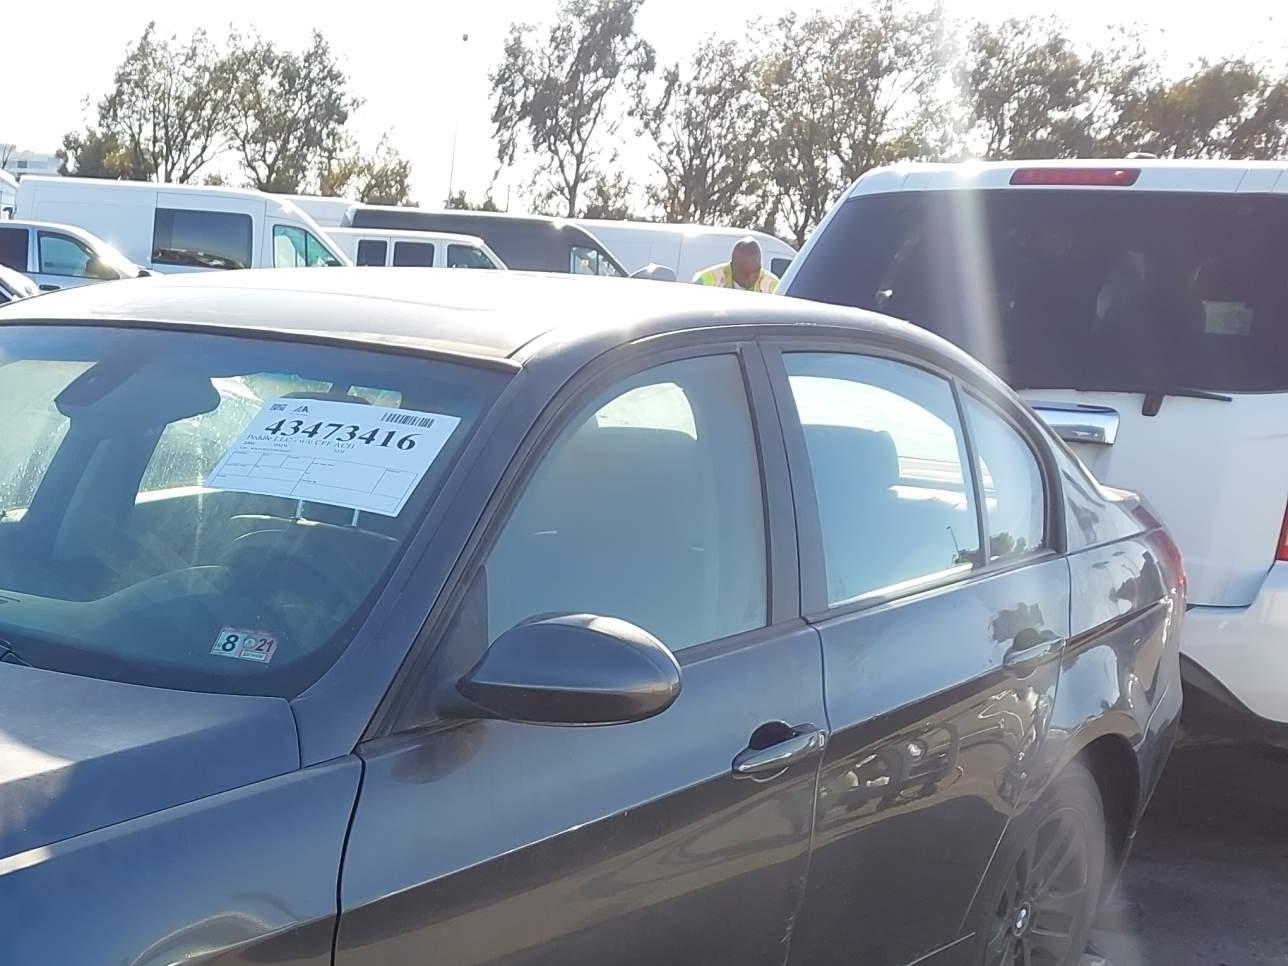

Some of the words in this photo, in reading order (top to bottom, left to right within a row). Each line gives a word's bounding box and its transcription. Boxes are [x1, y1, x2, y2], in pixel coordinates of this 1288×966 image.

[264, 418, 422, 451] 43473416
[222, 634, 239, 652] 8
[255, 638, 274, 653] 21
